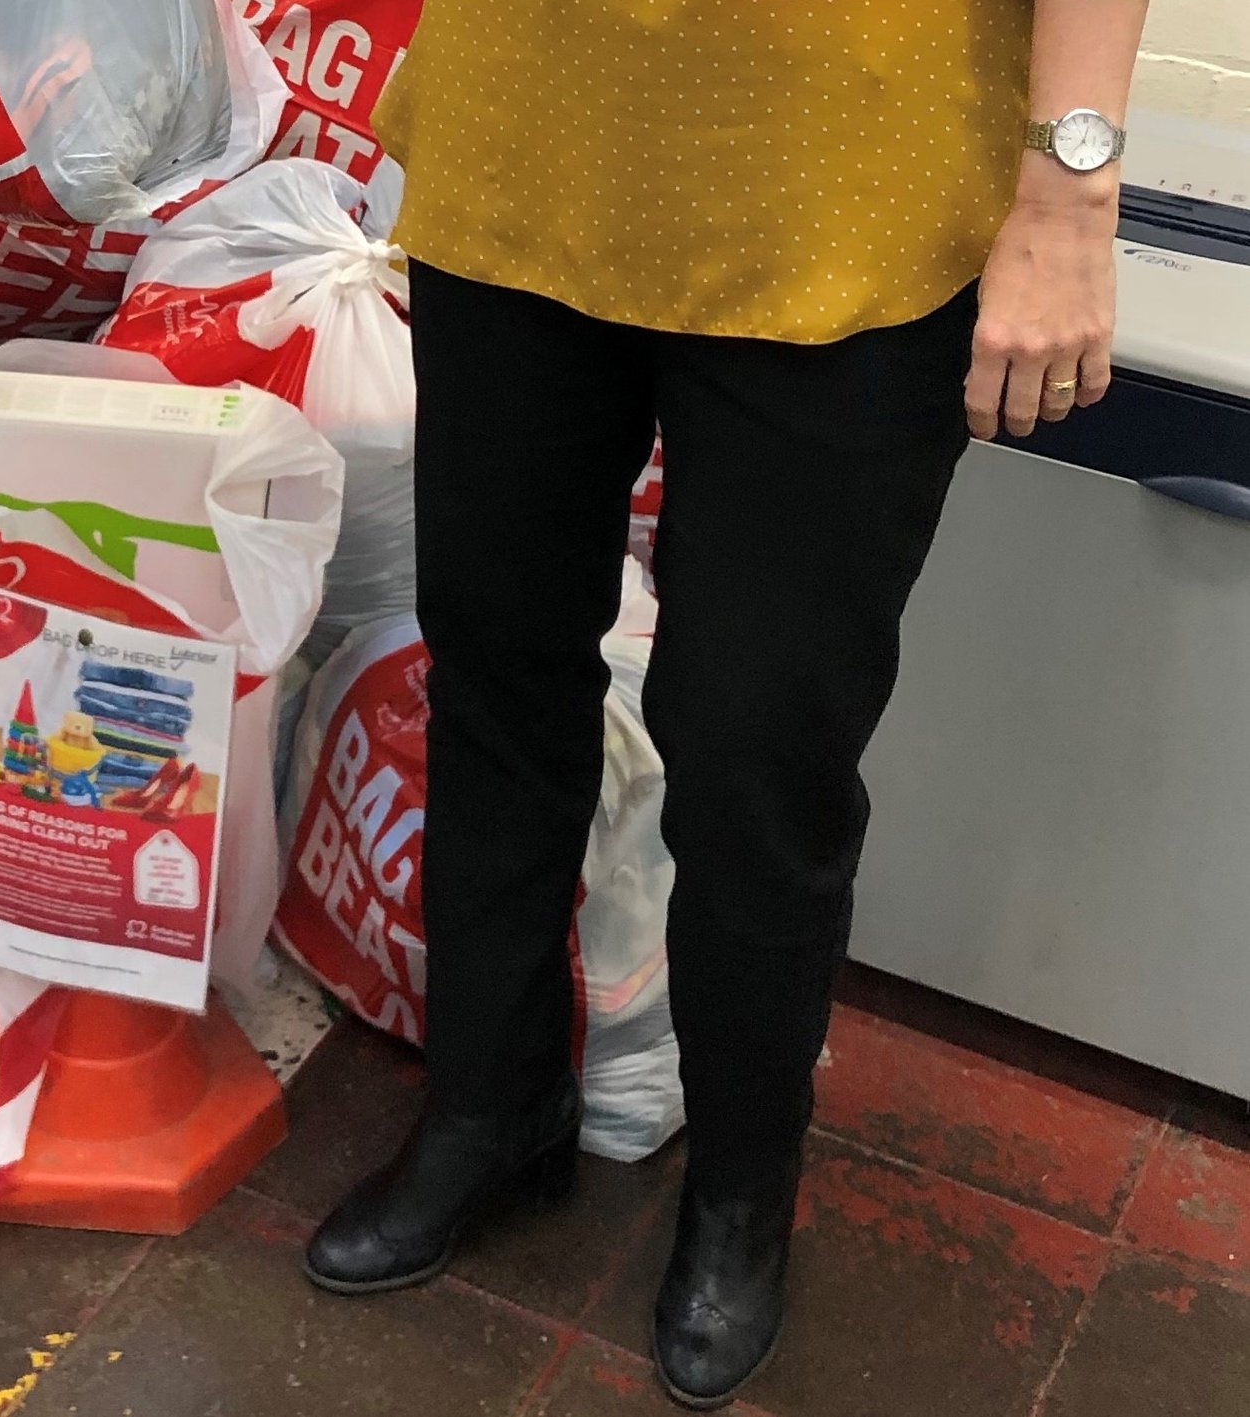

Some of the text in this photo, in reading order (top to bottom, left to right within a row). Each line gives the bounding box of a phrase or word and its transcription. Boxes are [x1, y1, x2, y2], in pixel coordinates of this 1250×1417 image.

[269, 109, 378, 176] AT
[42, 628, 72, 648] BAG
[122, 650, 167, 669] HERE
[8, 803, 28, 819] OF
[28, 808, 95, 836] REASONS
[97, 824, 128, 841] FOR
[326, 707, 425, 906] BAG
[31, 822, 76, 846] CLEAR
[77, 834, 111, 852] OUT
